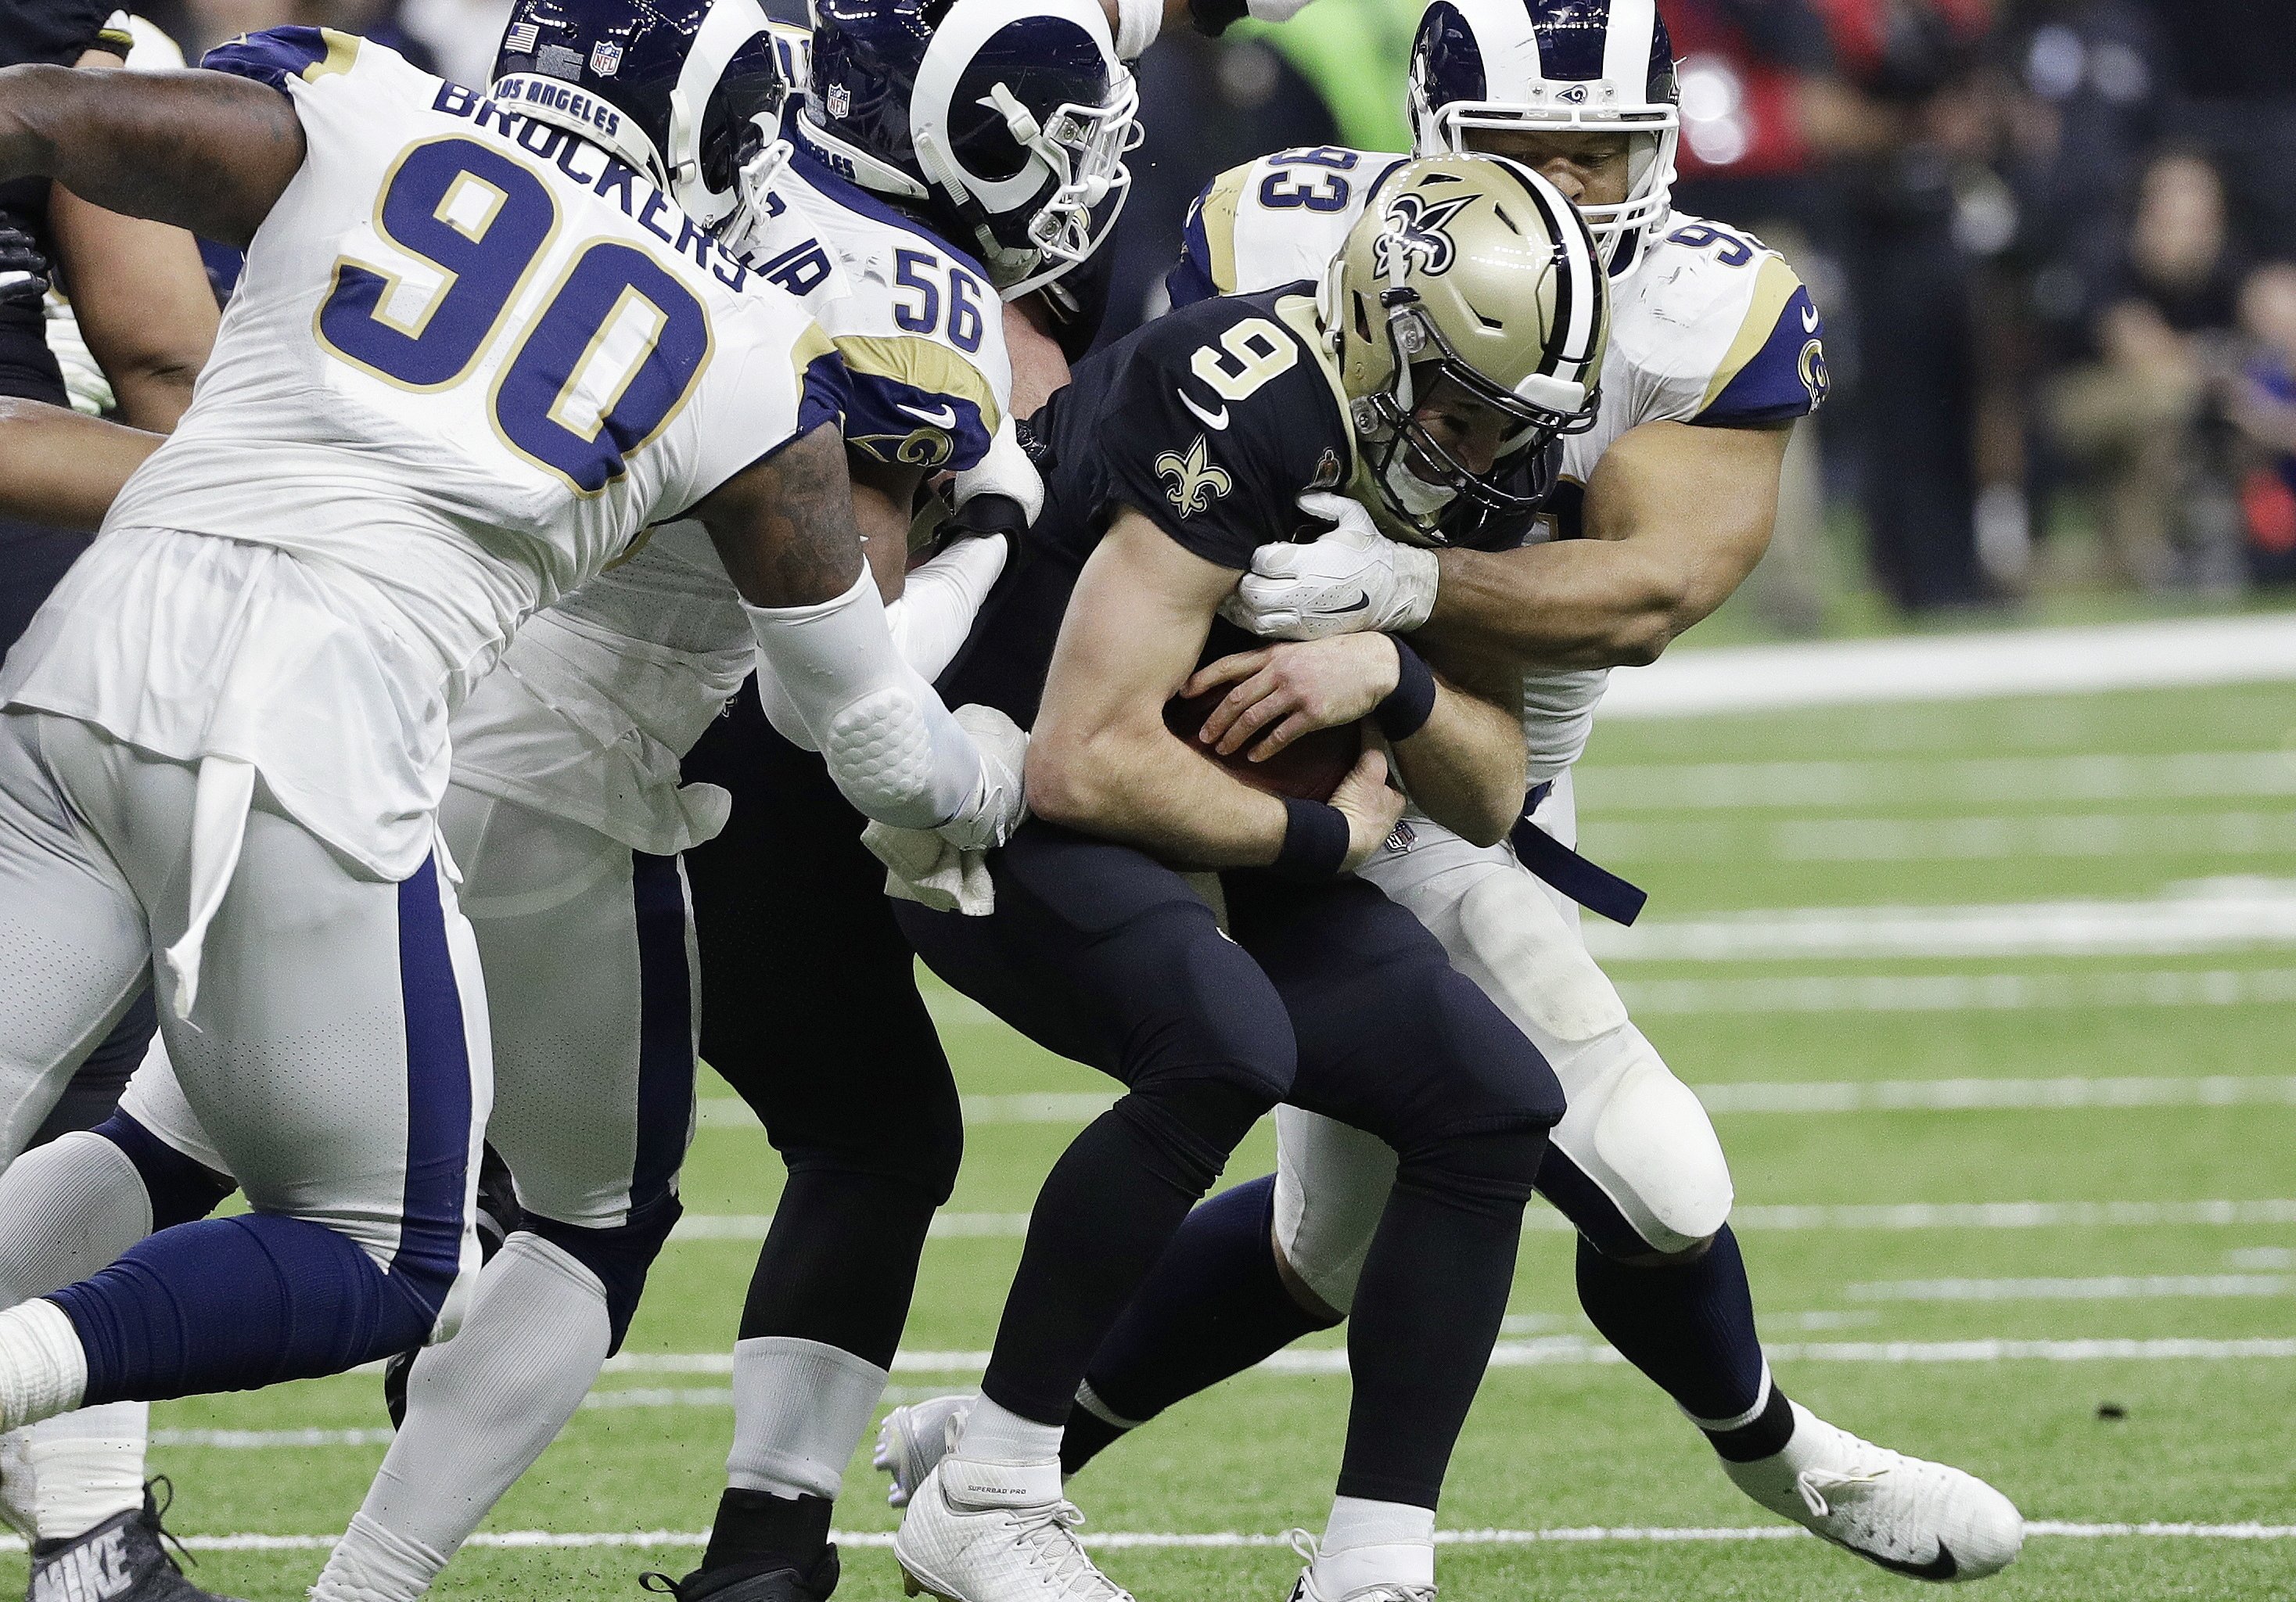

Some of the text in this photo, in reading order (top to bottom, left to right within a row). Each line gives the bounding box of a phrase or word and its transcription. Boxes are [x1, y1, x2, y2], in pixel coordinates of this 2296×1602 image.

[595, 56, 614, 72] NFL
[494, 78, 620, 137] LOS ANGELES
[829, 98, 846, 113] NFL
[431, 80, 749, 293] BROCKERS
[1257, 146, 1361, 215] 93
[312, 132, 715, 499] 90
[892, 246, 984, 357] 56
[1191, 316, 1299, 400] 9
[967, 1485, 1008, 1494] SUPERBAD
[34, 1525, 133, 1602] NIKE
